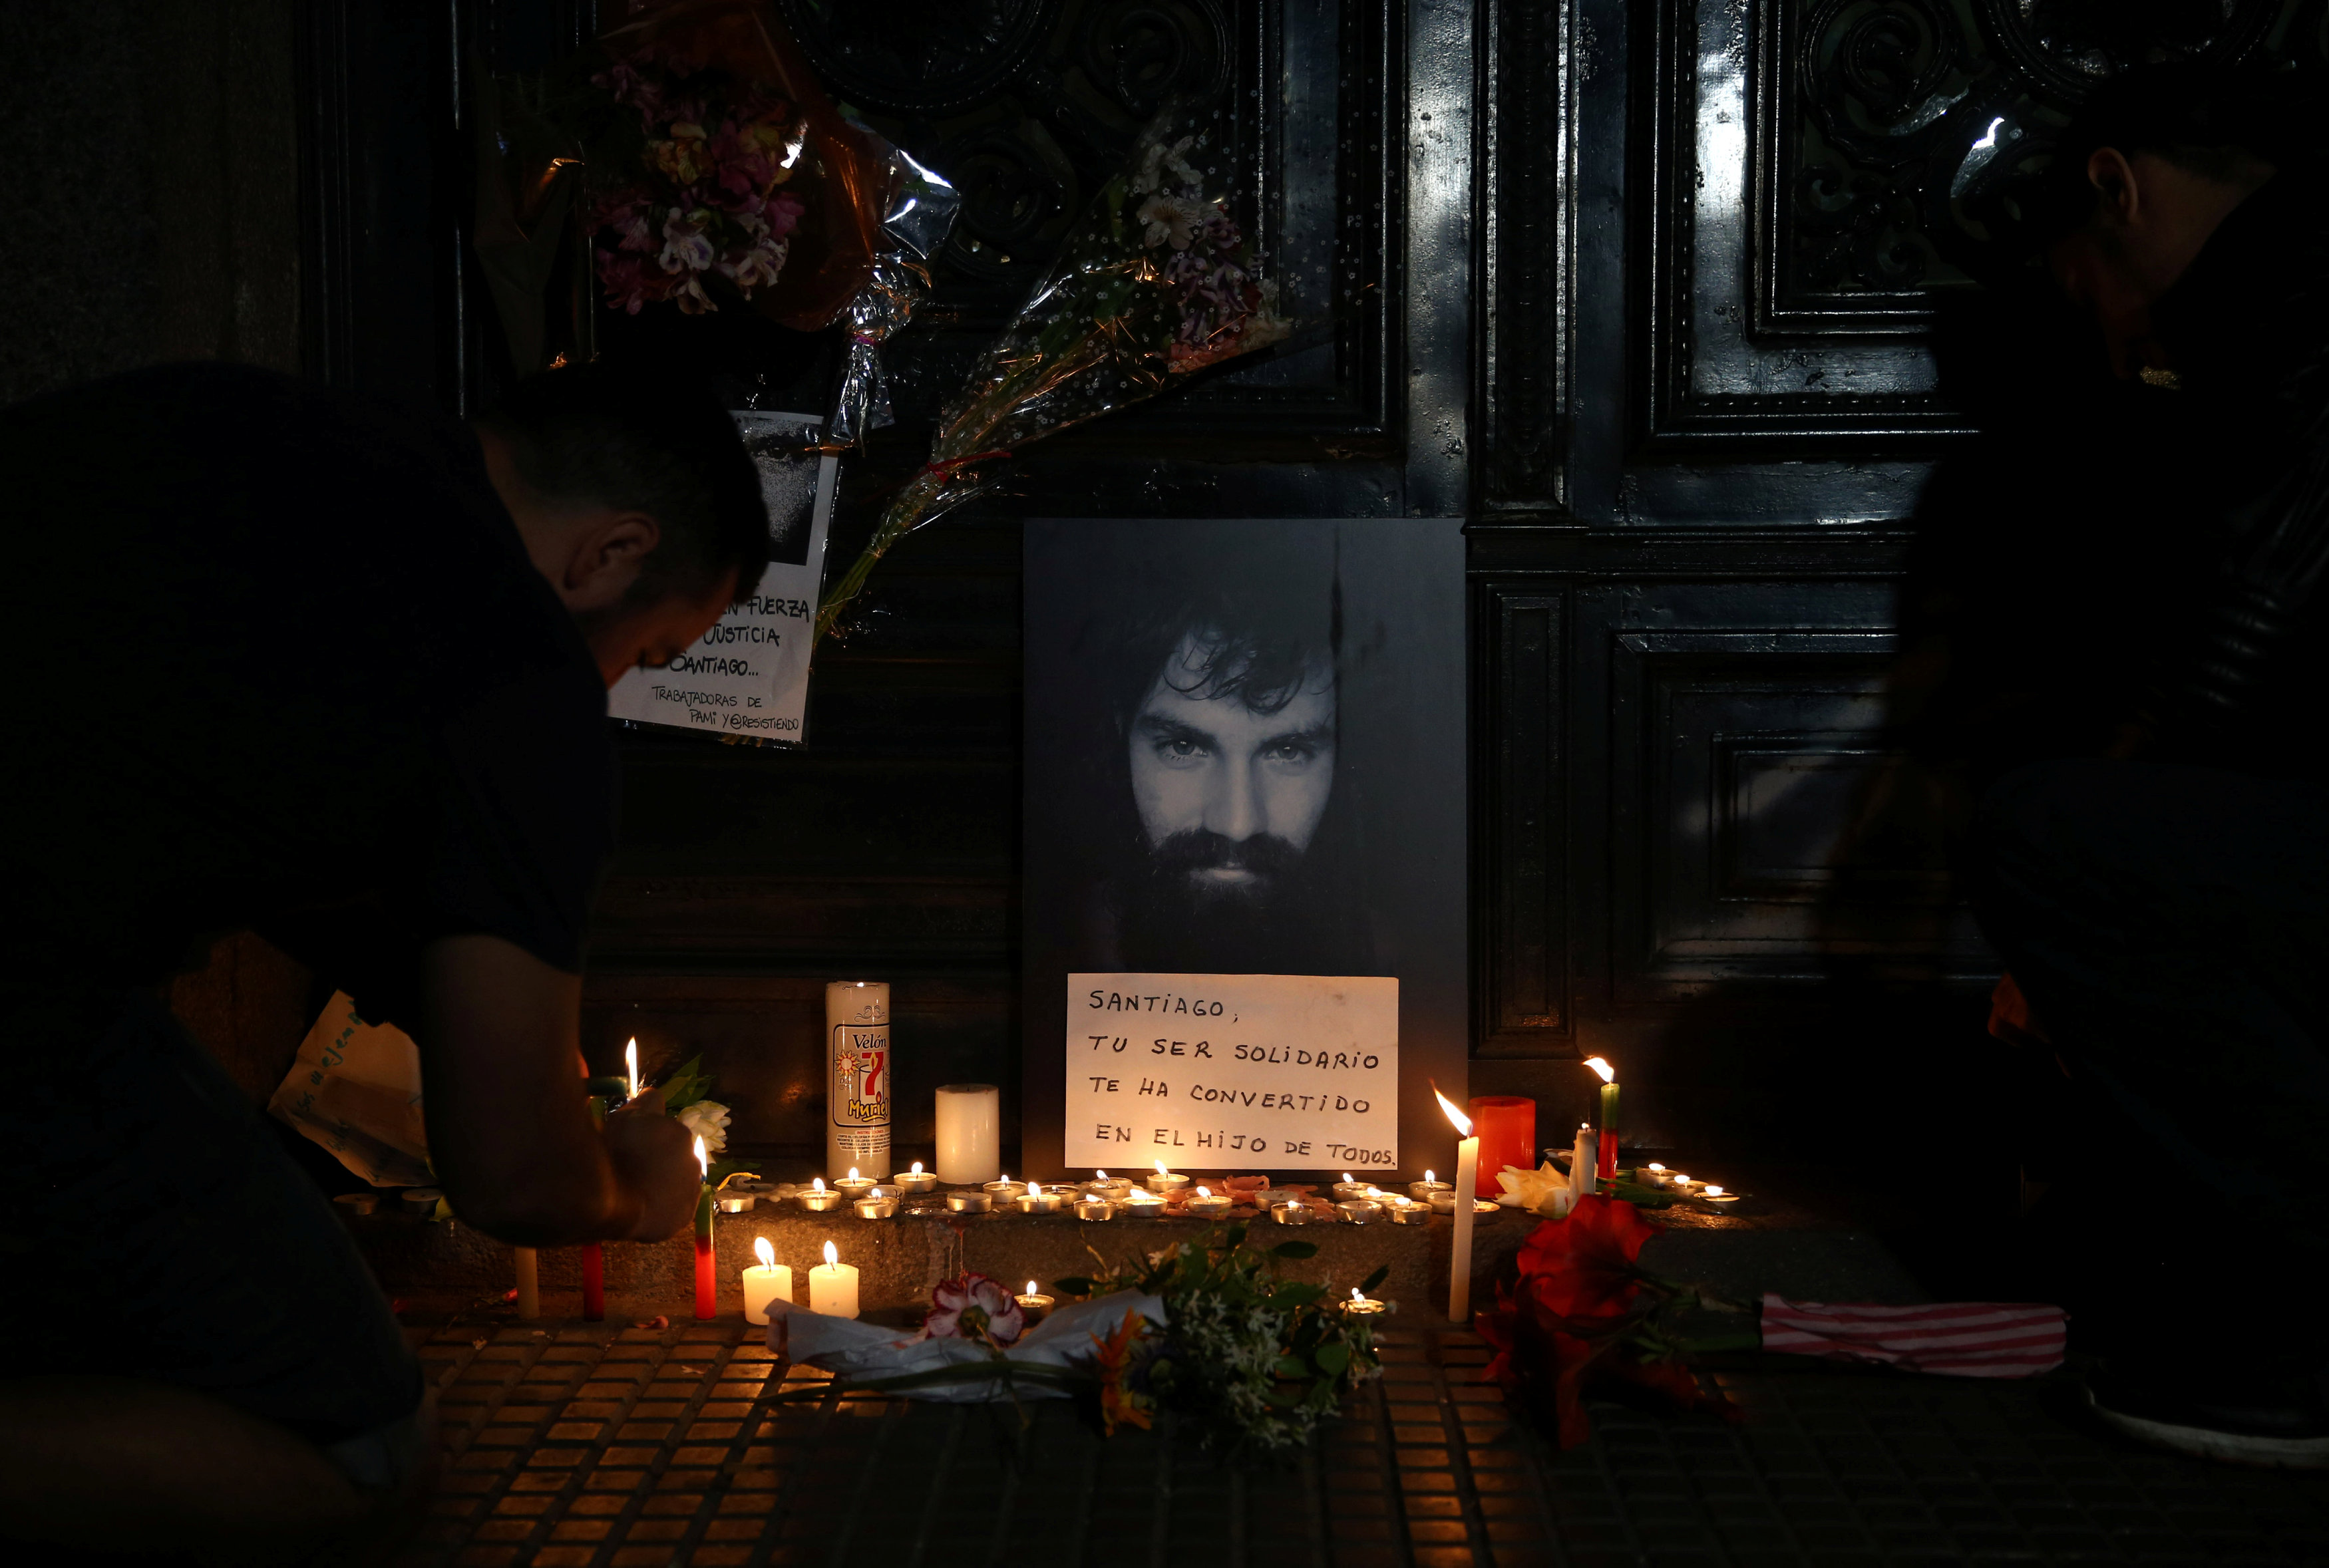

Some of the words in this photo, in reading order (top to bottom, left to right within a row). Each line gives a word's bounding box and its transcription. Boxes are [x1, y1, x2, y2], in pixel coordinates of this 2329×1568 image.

[747, 595, 810, 623] FUERZA
[651, 685, 738, 707] TRABAJADORAS
[747, 697, 763, 708] DE
[852, 1034, 887, 1049] Velón
[1088, 1034, 1128, 1053] TU
[1151, 1038, 1214, 1059] SER
[861, 1051, 884, 1096] 7
[1089, 1076, 1121, 1093] TE
[1138, 1076, 1169, 1098] HA
[848, 1096, 888, 1120] Muriel
[1095, 1123, 1132, 1142] EN
[1153, 1128, 1186, 1147] EL
[1284, 1140, 1312, 1156] DE
[1326, 1142, 1397, 1167] TODOS.
